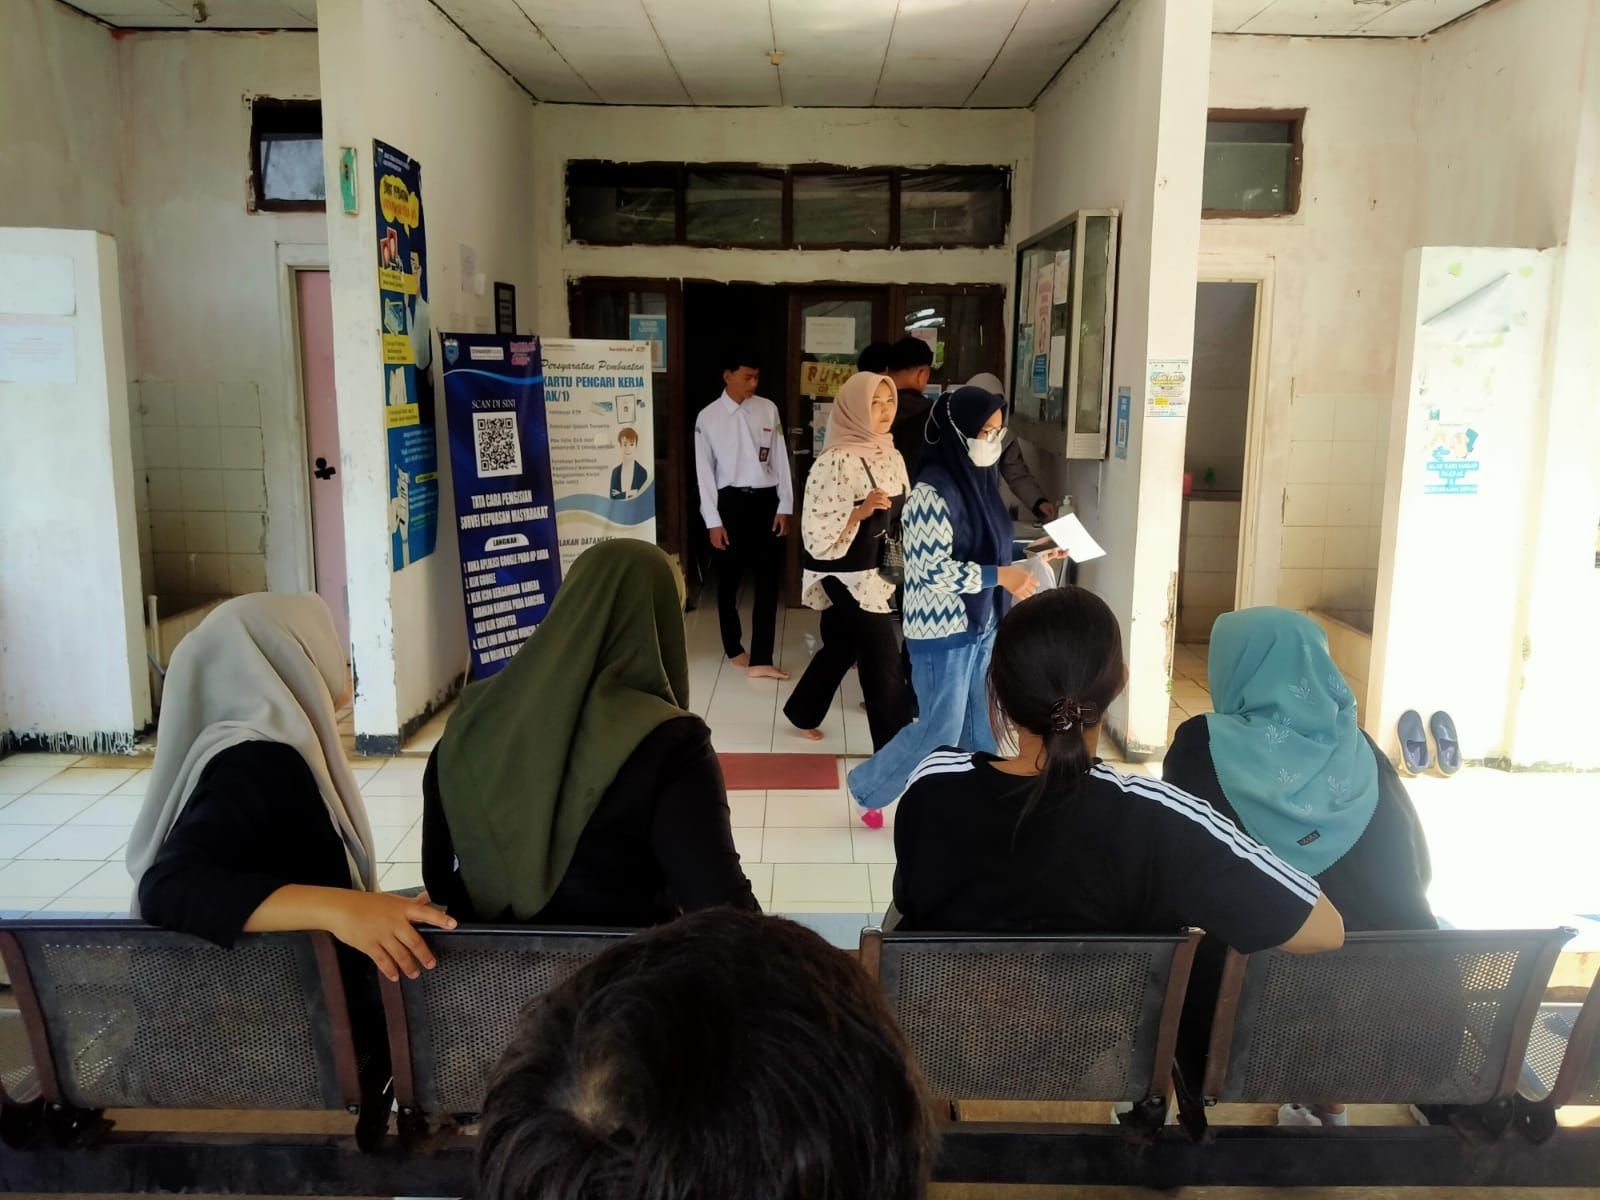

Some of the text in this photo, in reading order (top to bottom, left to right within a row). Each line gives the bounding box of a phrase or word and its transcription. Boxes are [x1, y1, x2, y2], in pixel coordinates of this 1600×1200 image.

[540, 359, 645, 372] Persyaratan Pembuatan
[575, 376, 615, 388] PENCARI
[618, 376, 645, 388] KERJA
[471, 399, 491, 409] SCAN
